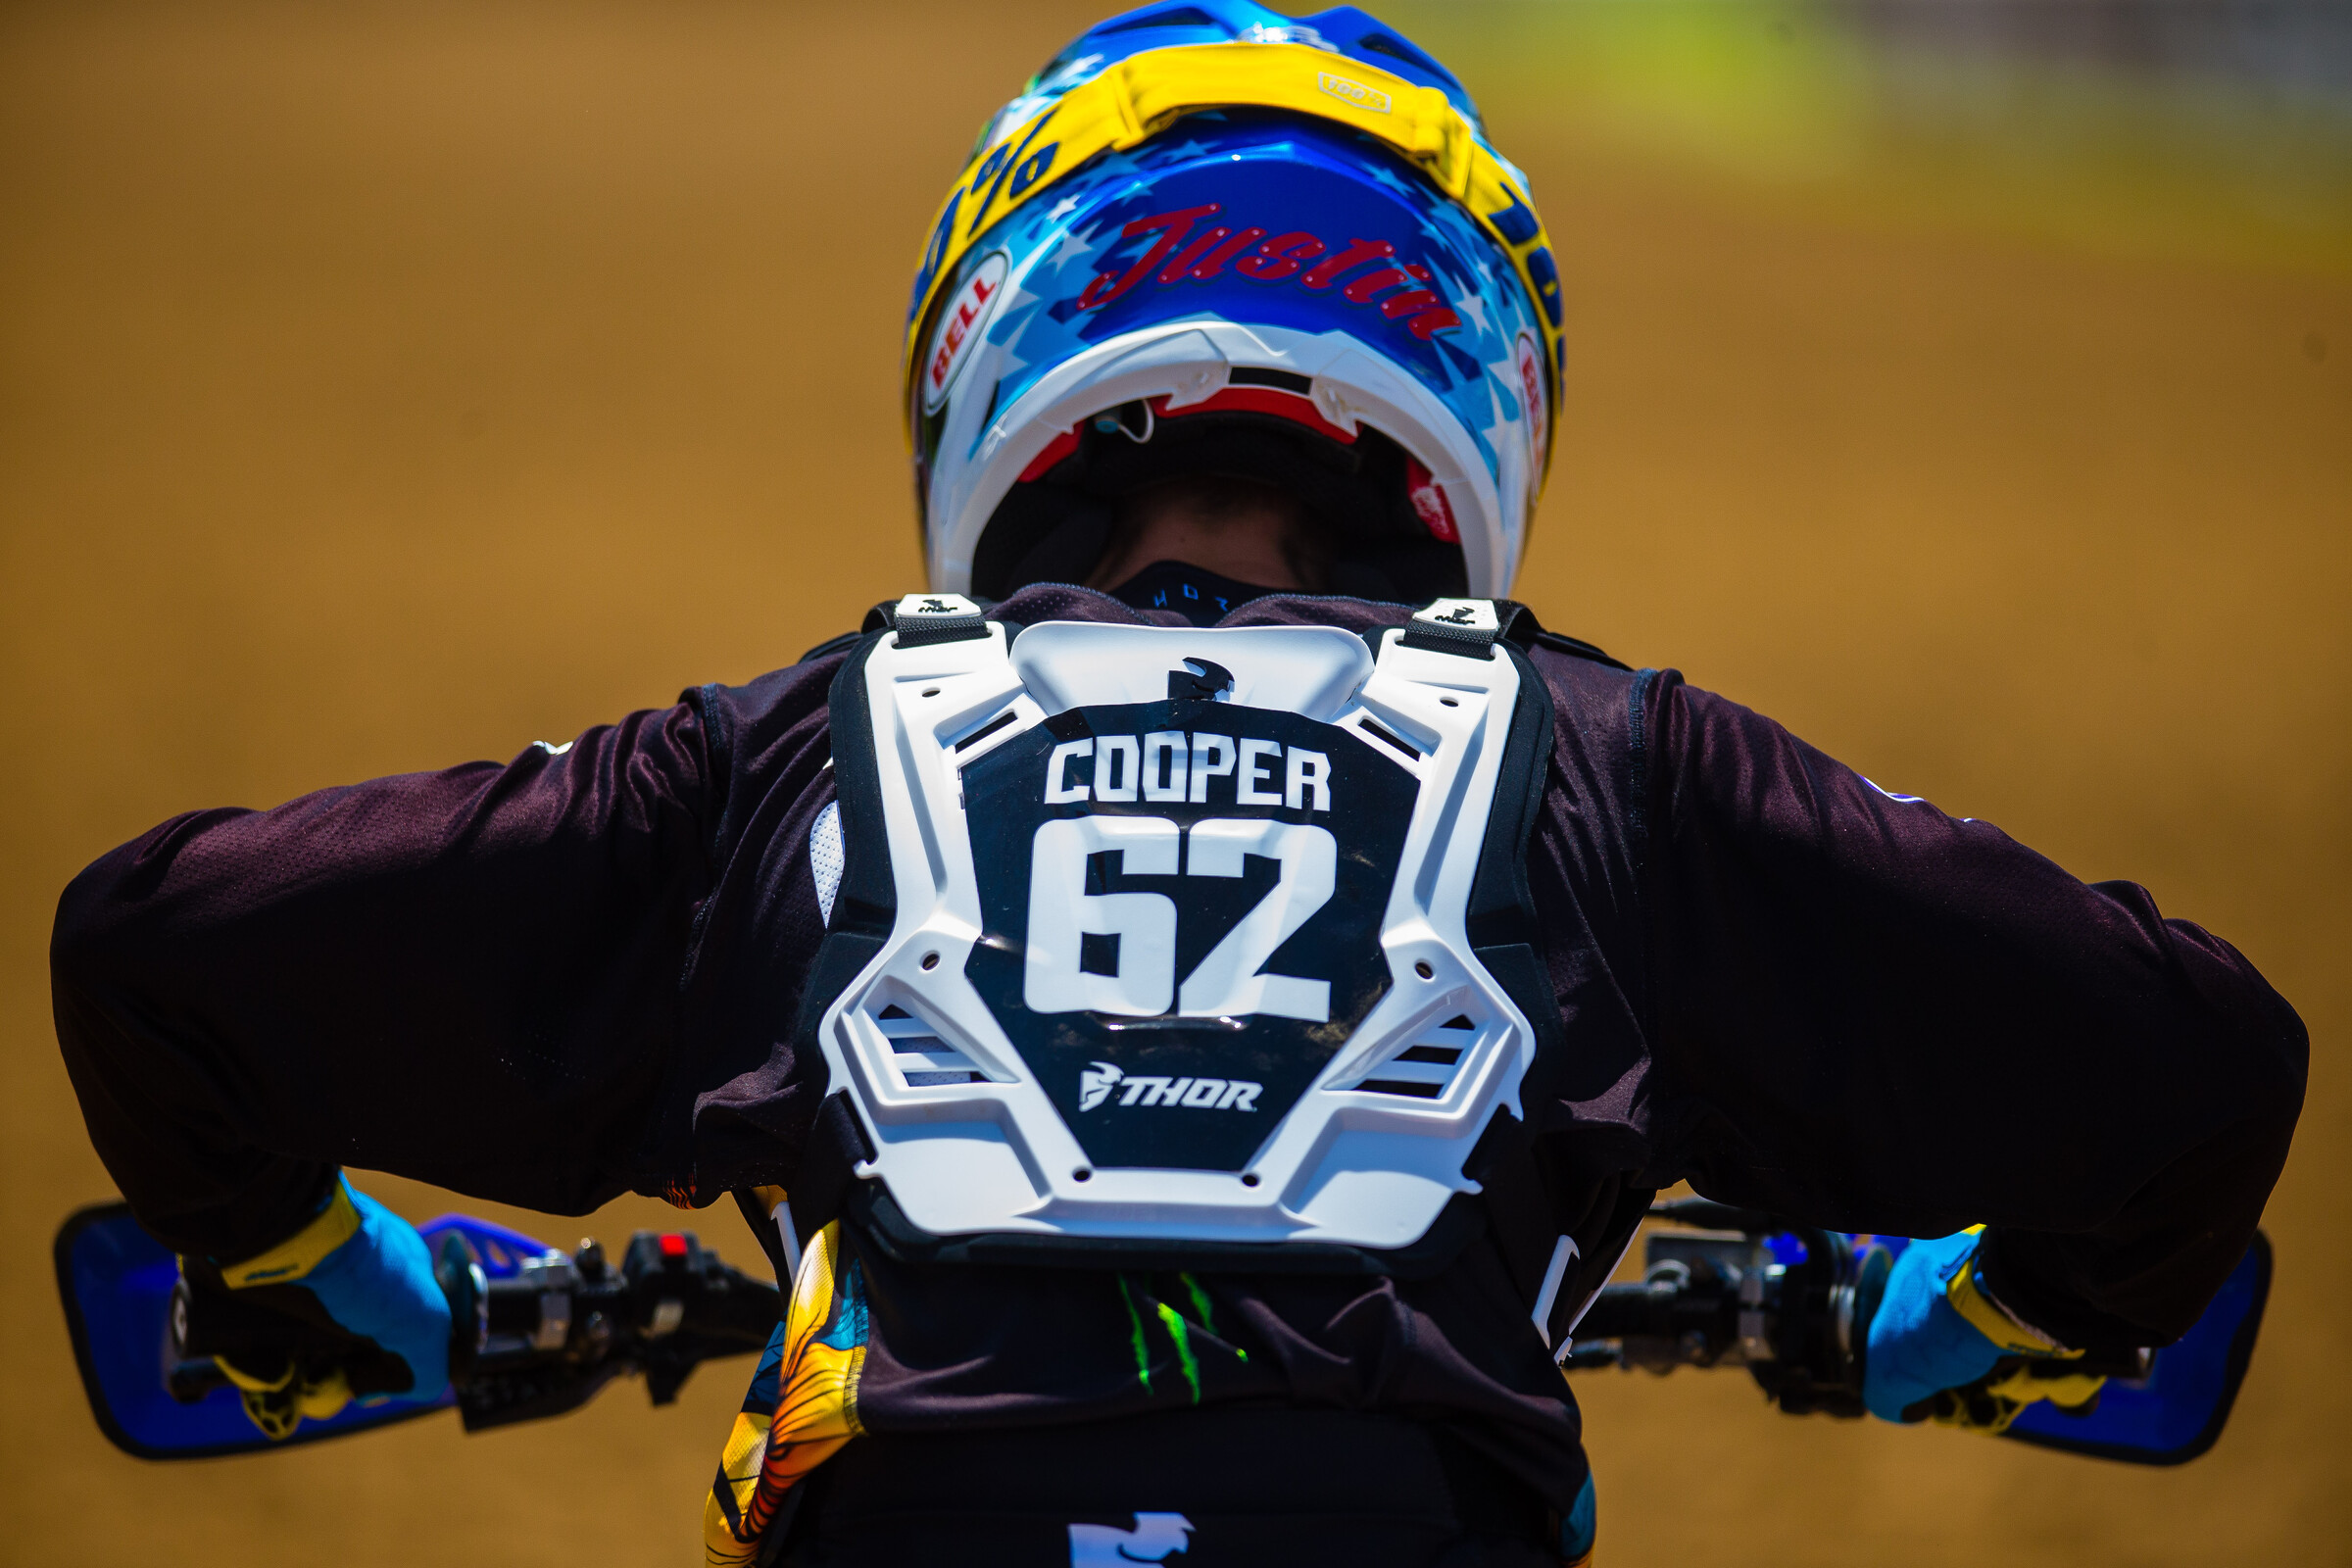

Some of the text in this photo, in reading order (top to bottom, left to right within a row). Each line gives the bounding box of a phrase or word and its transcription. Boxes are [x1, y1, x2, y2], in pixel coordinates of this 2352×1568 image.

[1076, 203, 1462, 341] Justin
[932, 275, 999, 390] BELL
[1044, 730, 1332, 811] COOPER
[1023, 814, 1338, 1023] 62
[1118, 1076, 1264, 1112] THOR
